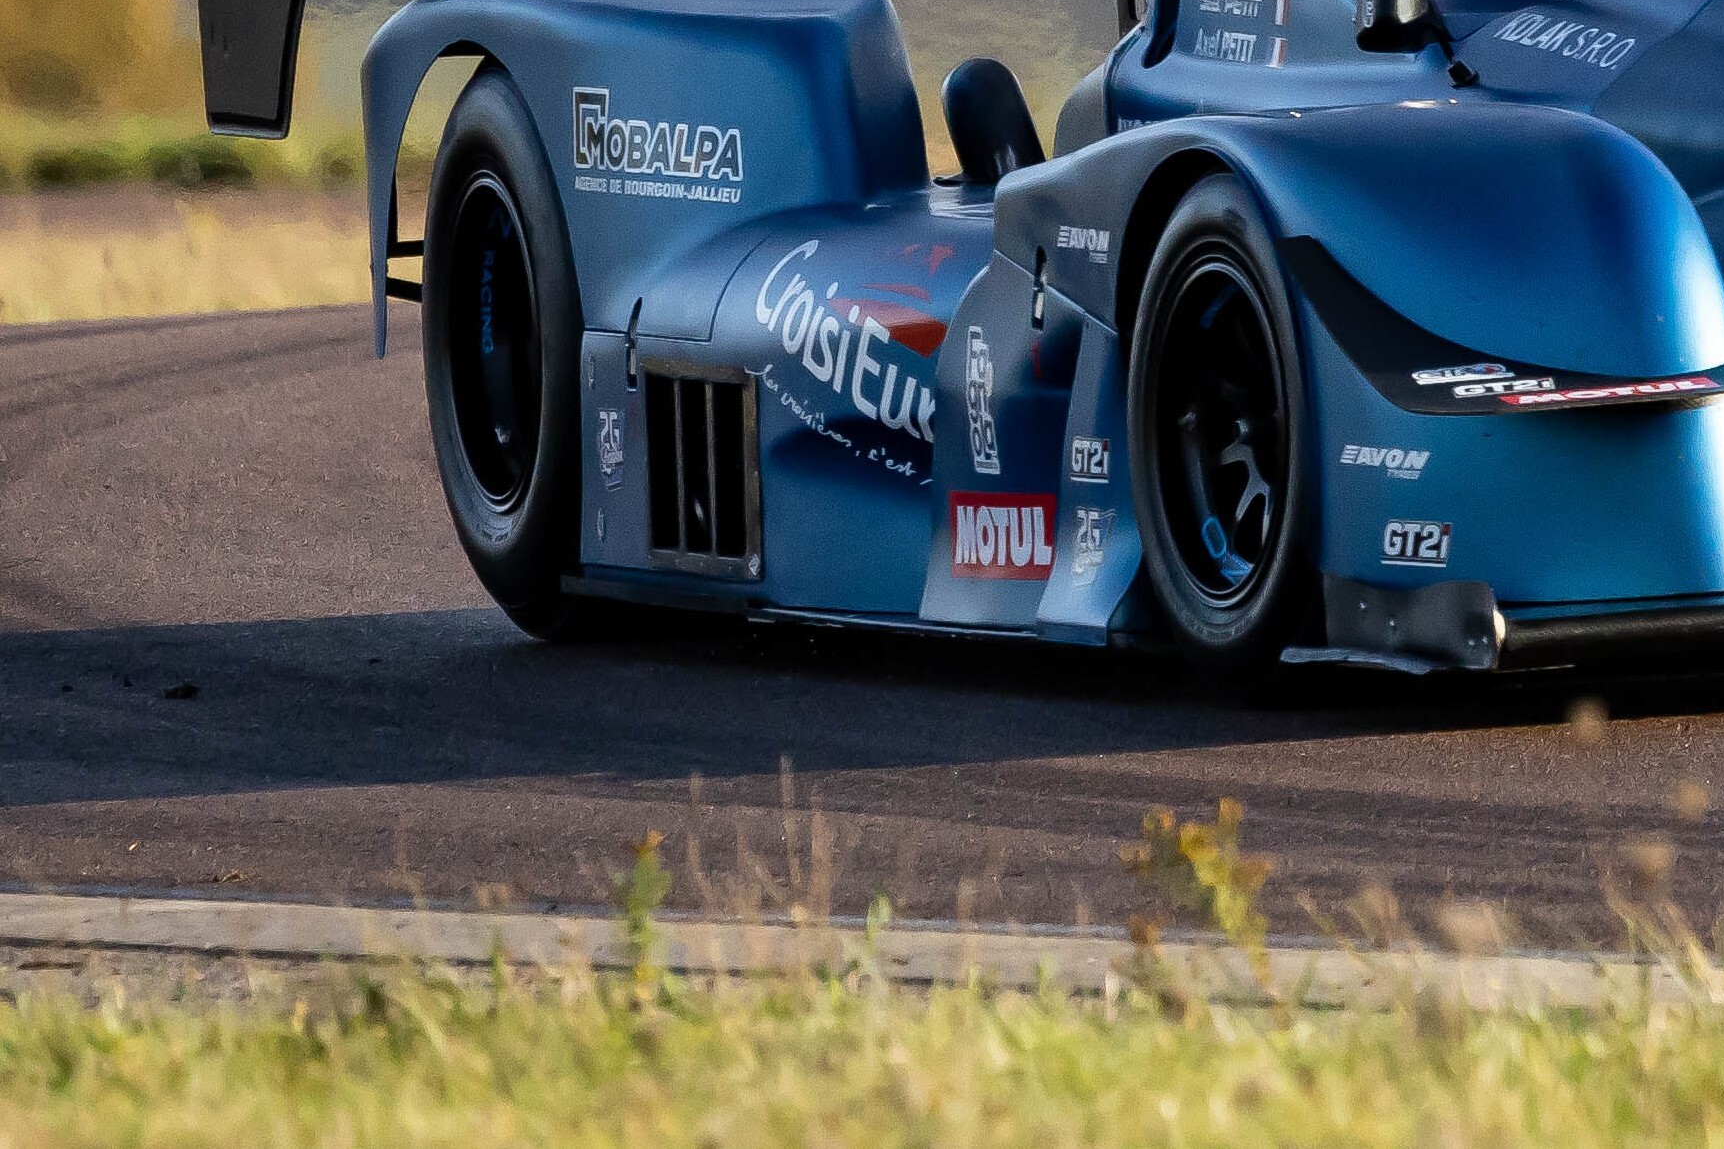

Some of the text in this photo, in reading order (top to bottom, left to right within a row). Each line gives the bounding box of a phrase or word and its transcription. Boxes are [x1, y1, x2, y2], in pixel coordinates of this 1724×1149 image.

[573, 86, 744, 182] MOBALPA
[1069, 227, 1111, 251] AVON
[755, 239, 936, 444] CroisiEur
[1517, 378, 1706, 405] MOTUL
[1356, 446, 1431, 470] AVON
[955, 505, 1053, 567] MOTUL
